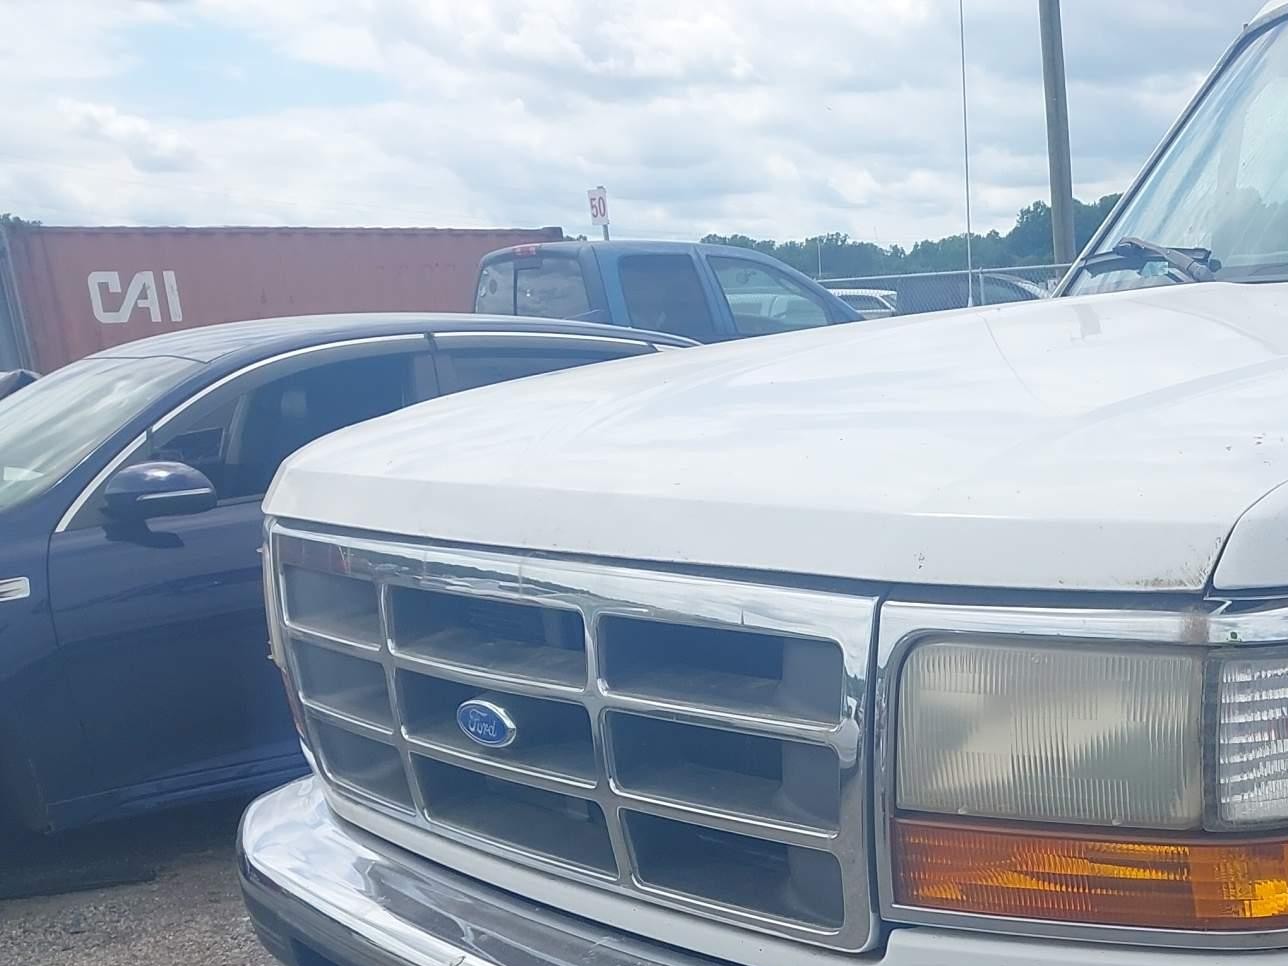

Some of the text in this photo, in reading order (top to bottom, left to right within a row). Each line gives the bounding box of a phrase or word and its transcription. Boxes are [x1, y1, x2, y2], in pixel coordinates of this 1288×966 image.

[590, 196, 606, 218] 50
[87, 270, 183, 324] CAI
[468, 708, 497, 737] Ford
